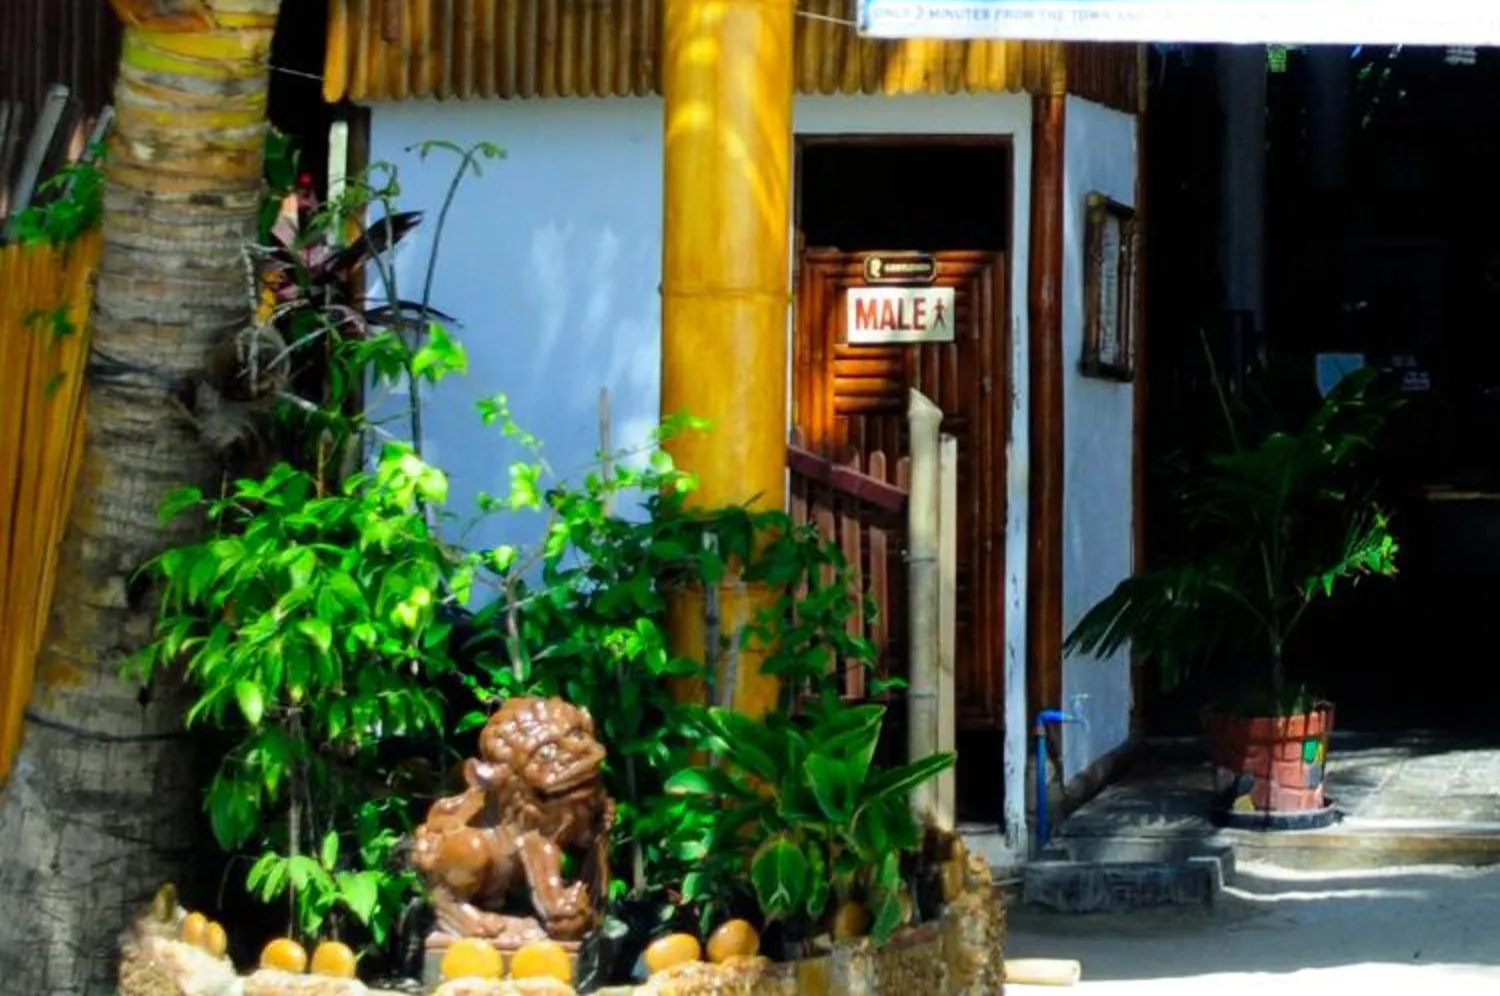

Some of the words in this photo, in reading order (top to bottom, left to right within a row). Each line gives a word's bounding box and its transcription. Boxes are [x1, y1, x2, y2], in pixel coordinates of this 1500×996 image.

[928, 7, 991, 21] MINUTES
[994, 8, 1035, 21] FROM
[855, 297, 927, 331] MALE
